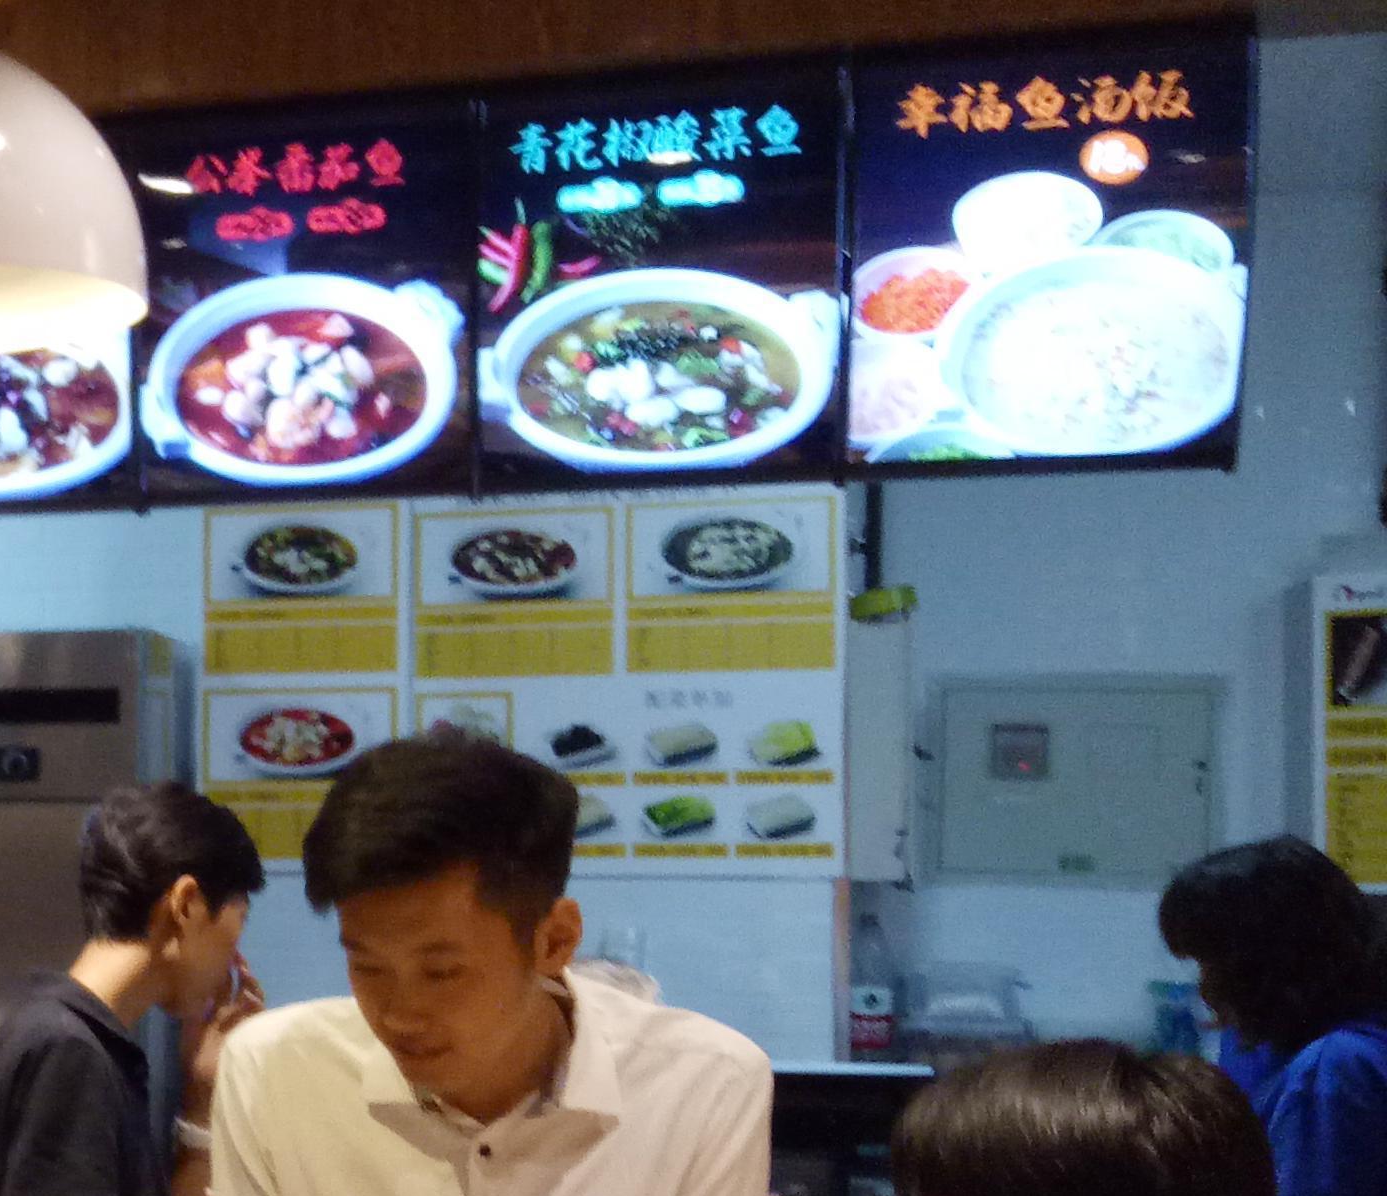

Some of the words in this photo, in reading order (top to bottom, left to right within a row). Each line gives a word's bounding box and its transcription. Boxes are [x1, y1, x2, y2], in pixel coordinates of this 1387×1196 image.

[895, 69, 1195, 140] 幸福鱼汤饭
